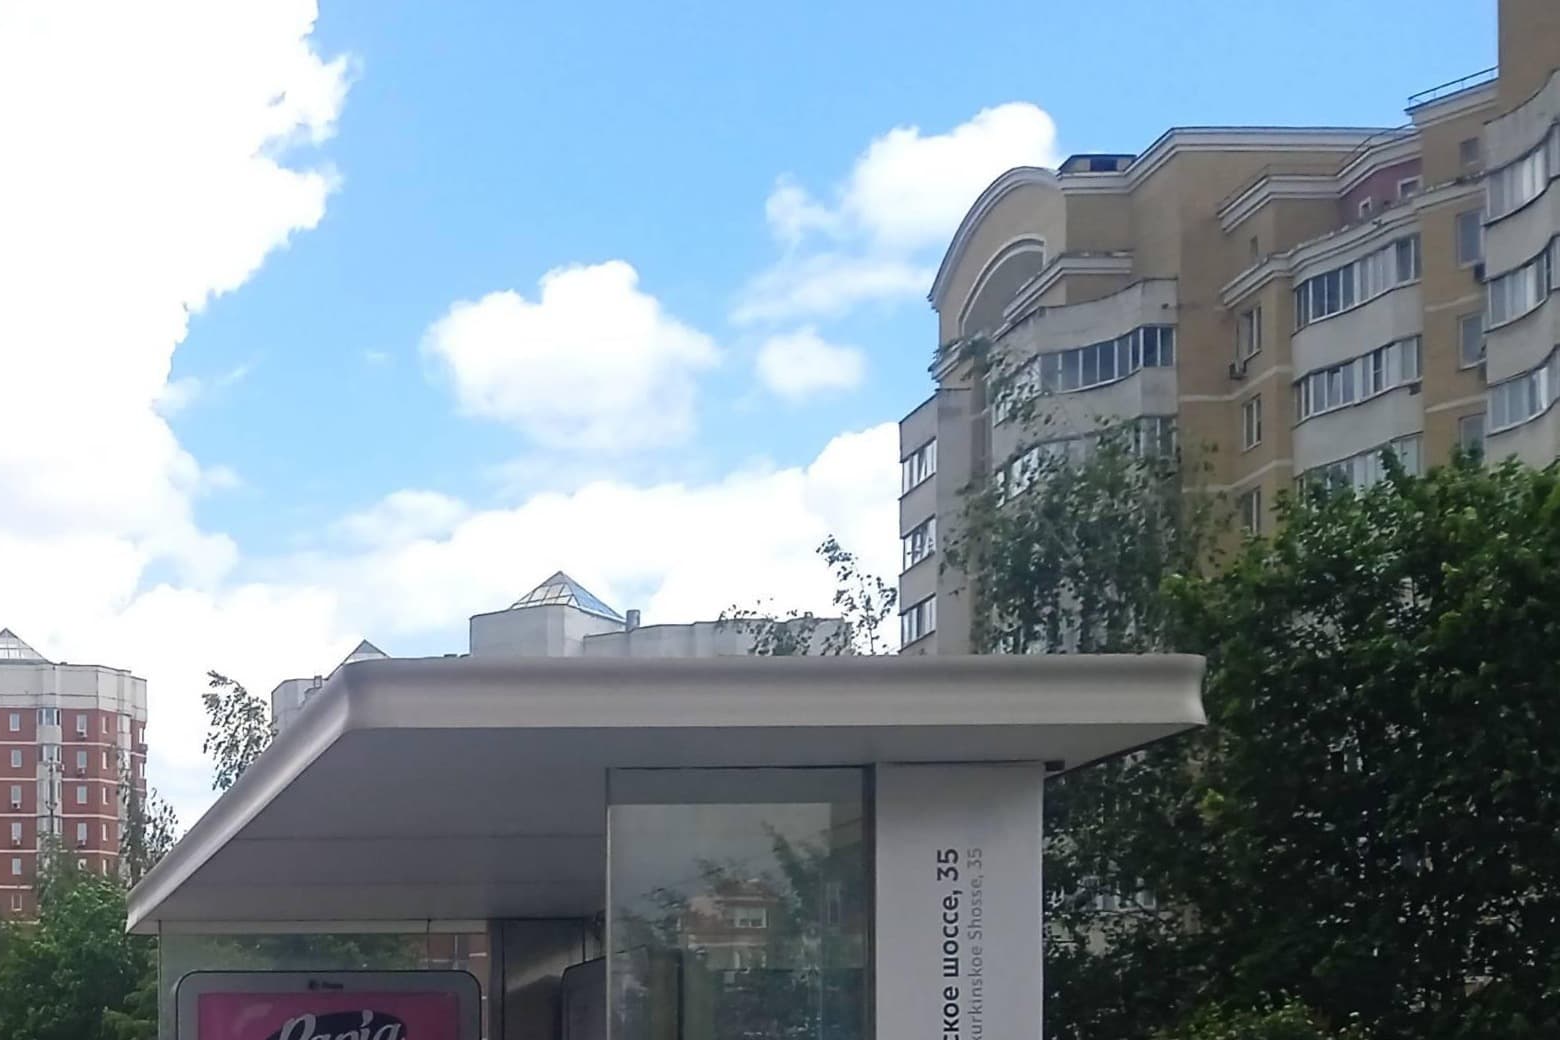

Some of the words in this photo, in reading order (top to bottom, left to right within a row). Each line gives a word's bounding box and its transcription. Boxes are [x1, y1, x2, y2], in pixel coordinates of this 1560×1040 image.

[936, 848, 959, 882] 35
[967, 848, 982, 870] 35
[967, 874, 985, 940] Shosse,
[942, 889, 964, 978] шоссе,
